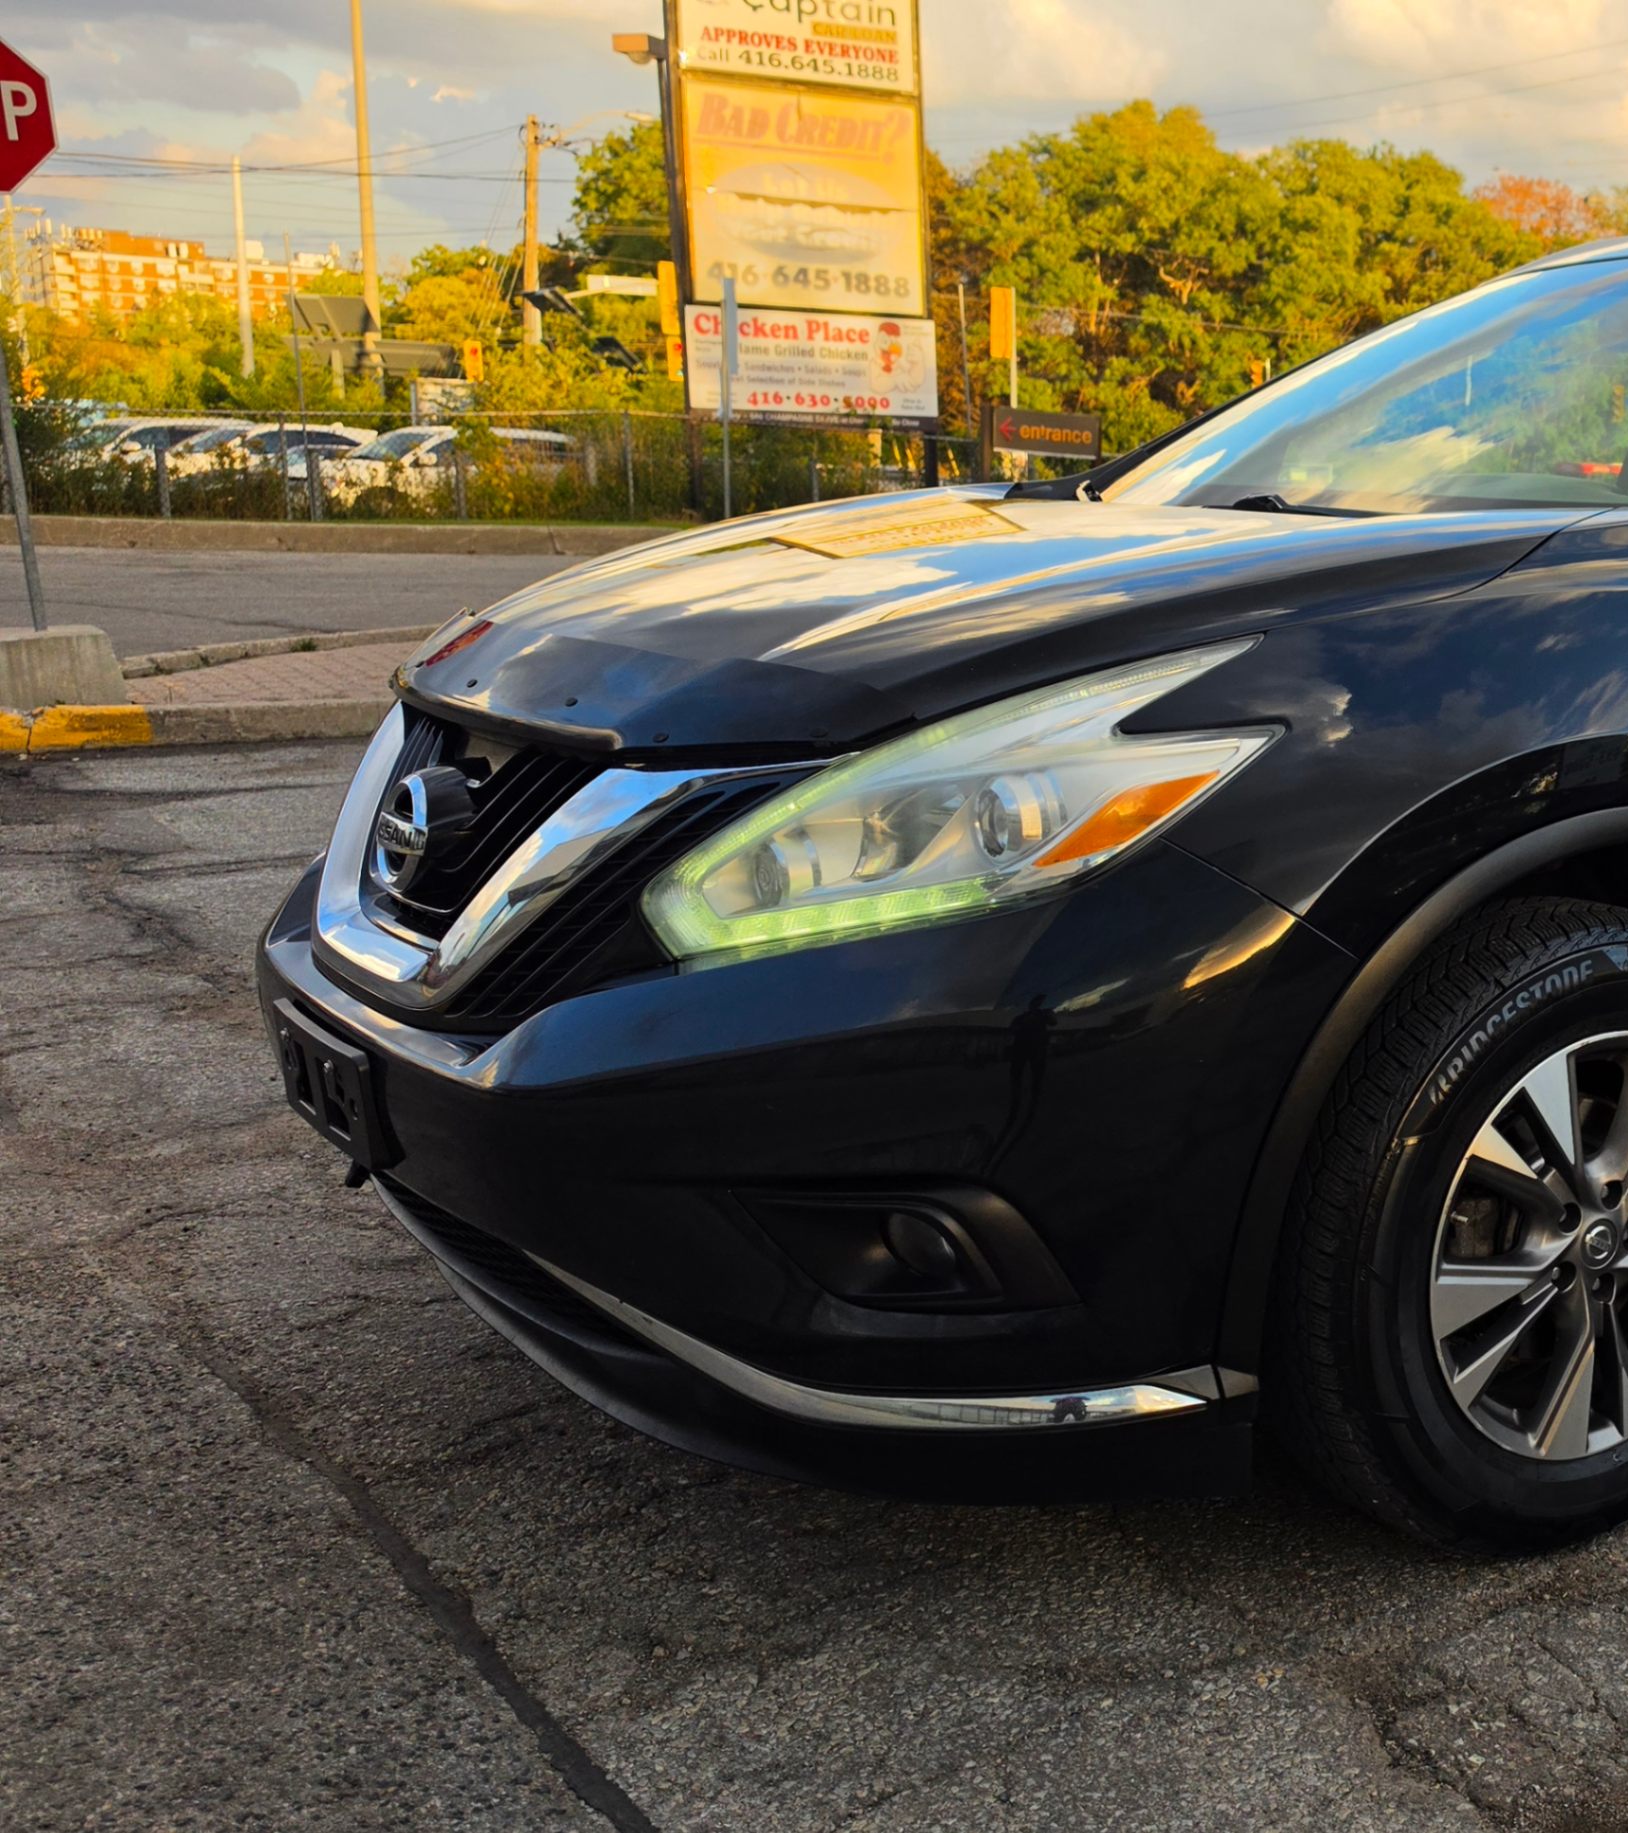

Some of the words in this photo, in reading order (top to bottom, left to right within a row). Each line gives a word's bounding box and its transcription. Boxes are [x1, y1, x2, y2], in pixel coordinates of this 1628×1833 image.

[700, 26, 798, 52] APPROVES
[803, 39, 899, 65] EVERYONE
[697, 48, 731, 63] Call
[738, 49, 899, 82] 416.645.1888
[693, 312, 799, 341] Chcken
[805, 318, 870, 344] Place
[739, 343, 771, 356] lame
[774, 345, 815, 359] Grilled
[819, 348, 868, 361] Chicken
[1019, 424, 1093, 445] entrance
